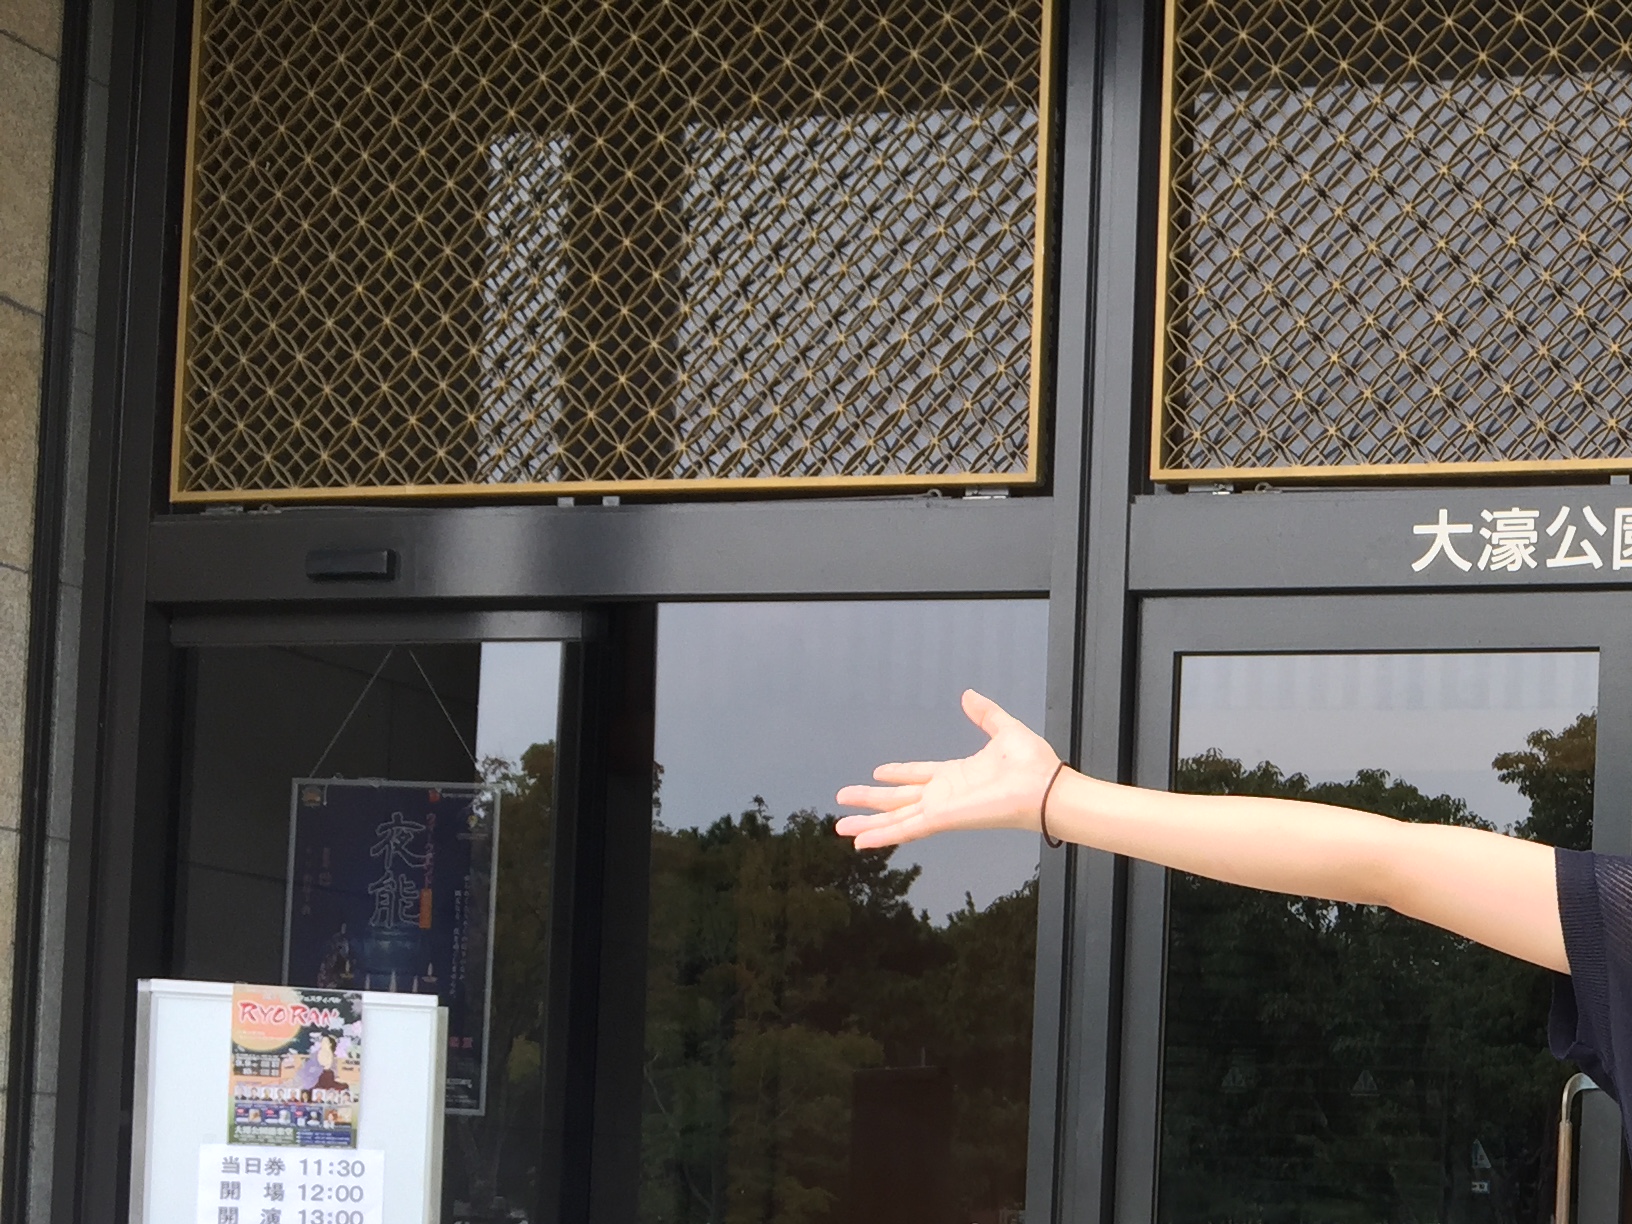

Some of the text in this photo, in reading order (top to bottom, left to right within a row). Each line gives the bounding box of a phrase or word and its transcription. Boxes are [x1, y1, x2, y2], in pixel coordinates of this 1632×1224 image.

[368, 811, 433, 929] 夜能
[221, 1156, 365, 1178] 当日券 11:30
[298, 1183, 364, 1202] 12:00
